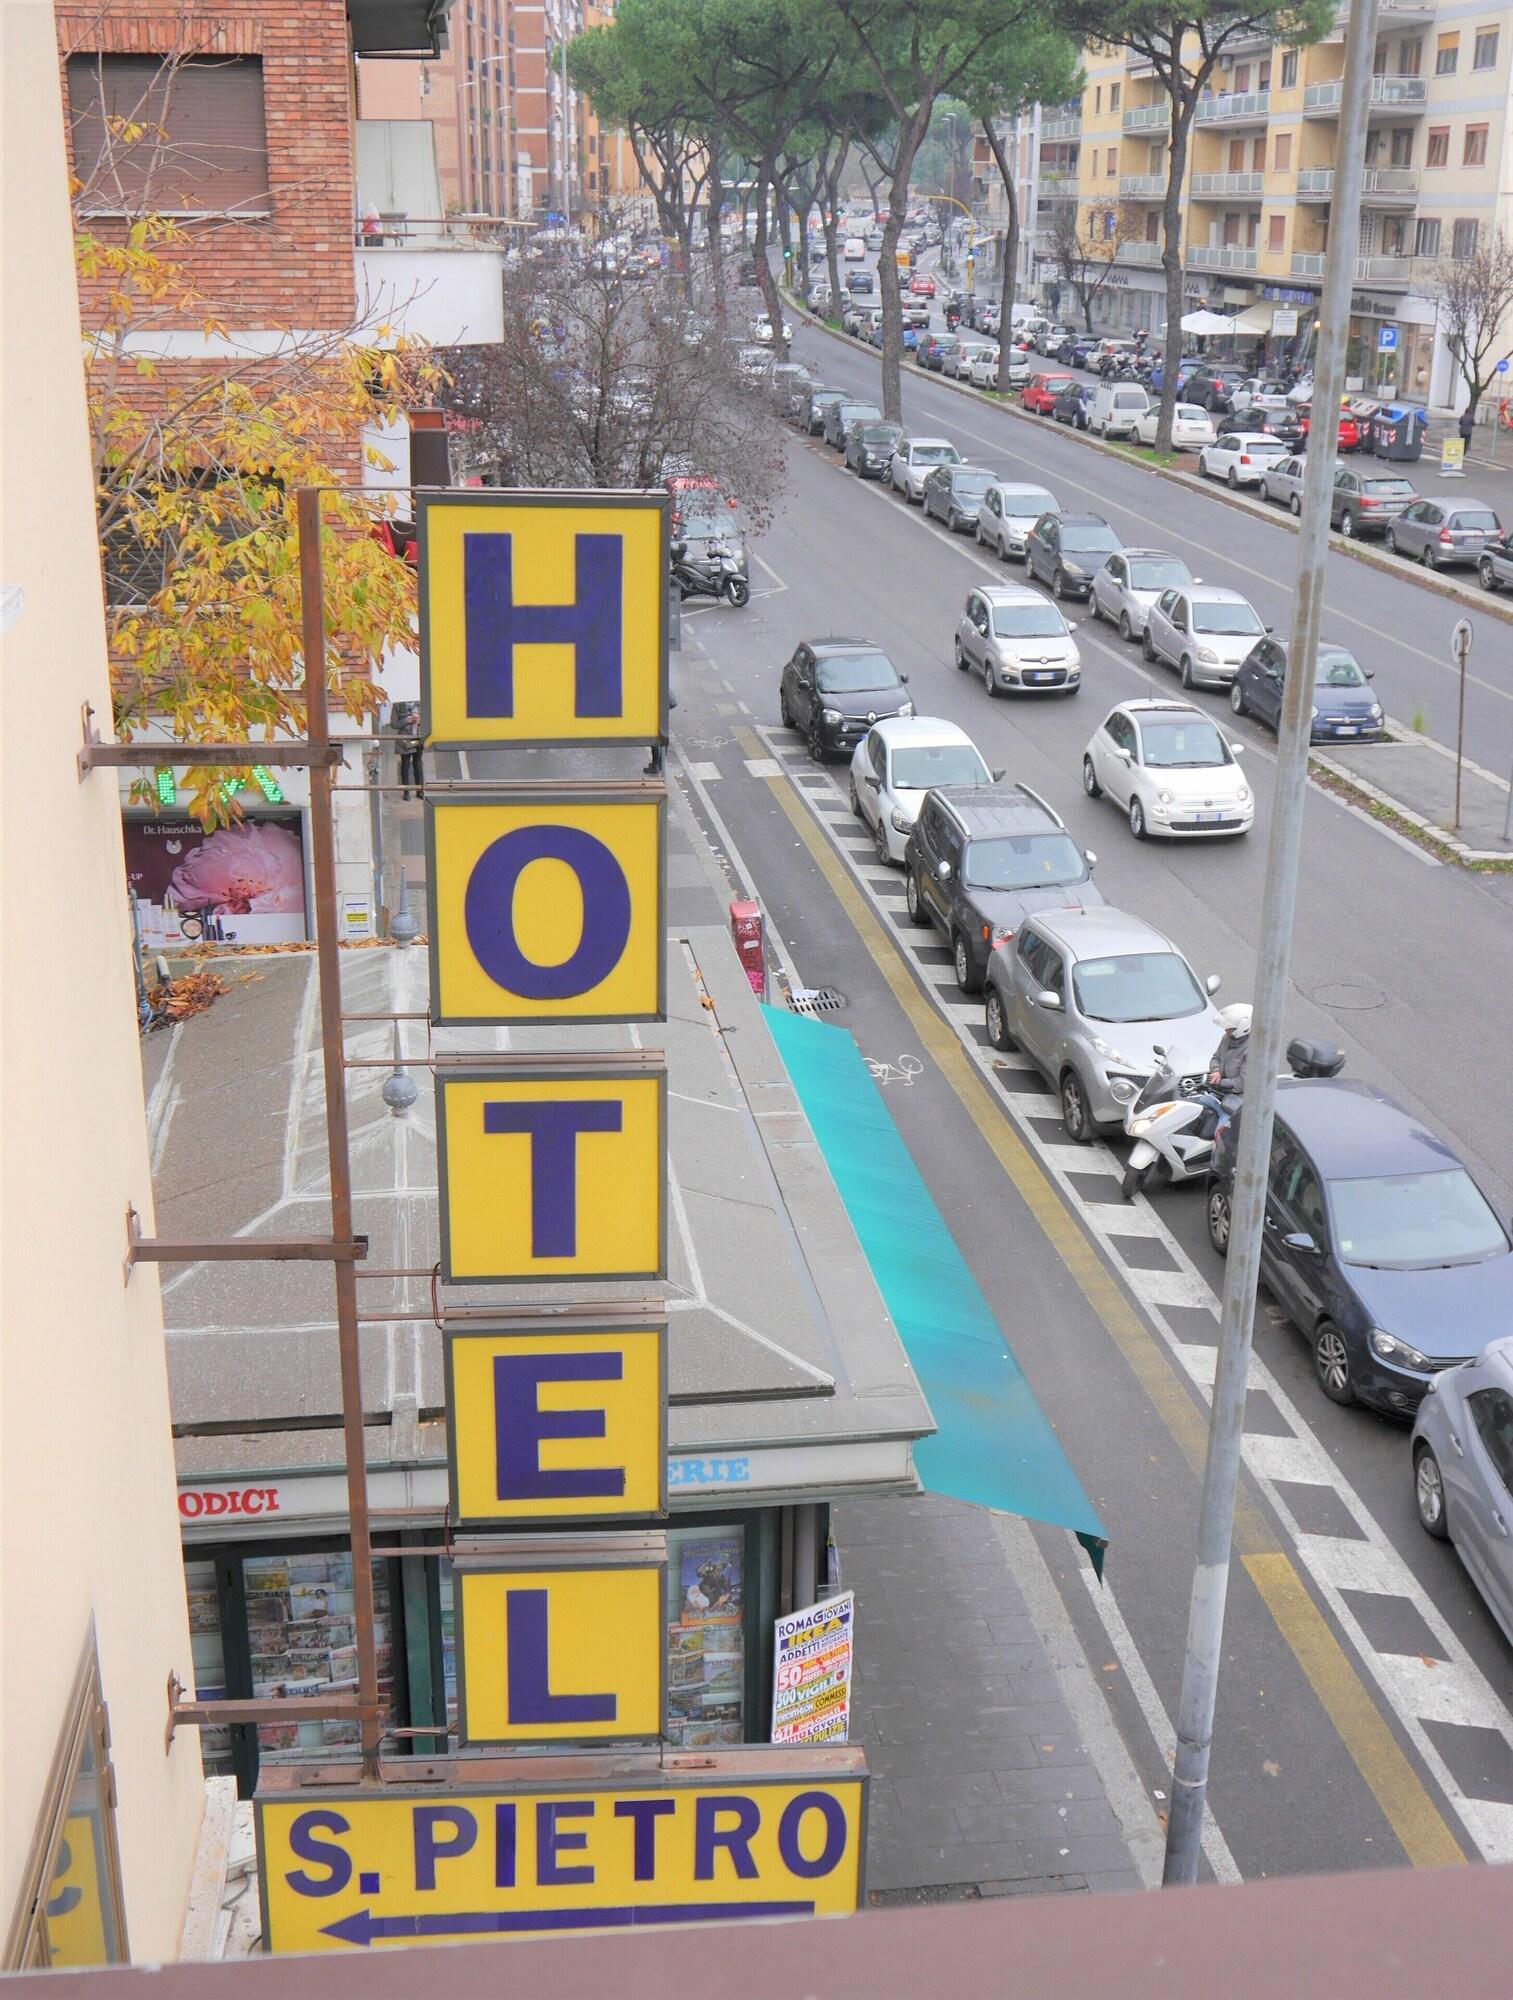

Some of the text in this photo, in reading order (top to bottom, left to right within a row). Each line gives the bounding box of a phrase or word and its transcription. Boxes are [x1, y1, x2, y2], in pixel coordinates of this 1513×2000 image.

[1382, 331, 1393, 345] P
[157, 824, 202, 834] Hauschka
[464, 532, 631, 1723] HOTEL
[177, 1488, 280, 1518] ODICI
[788, 1617, 844, 1649] IKEA
[780, 1641, 820, 1664] ADDETTI
[778, 1665, 802, 1690] 50
[777, 1688, 797, 1710] 500
[284, 1791, 847, 1898] S. PIETRO
